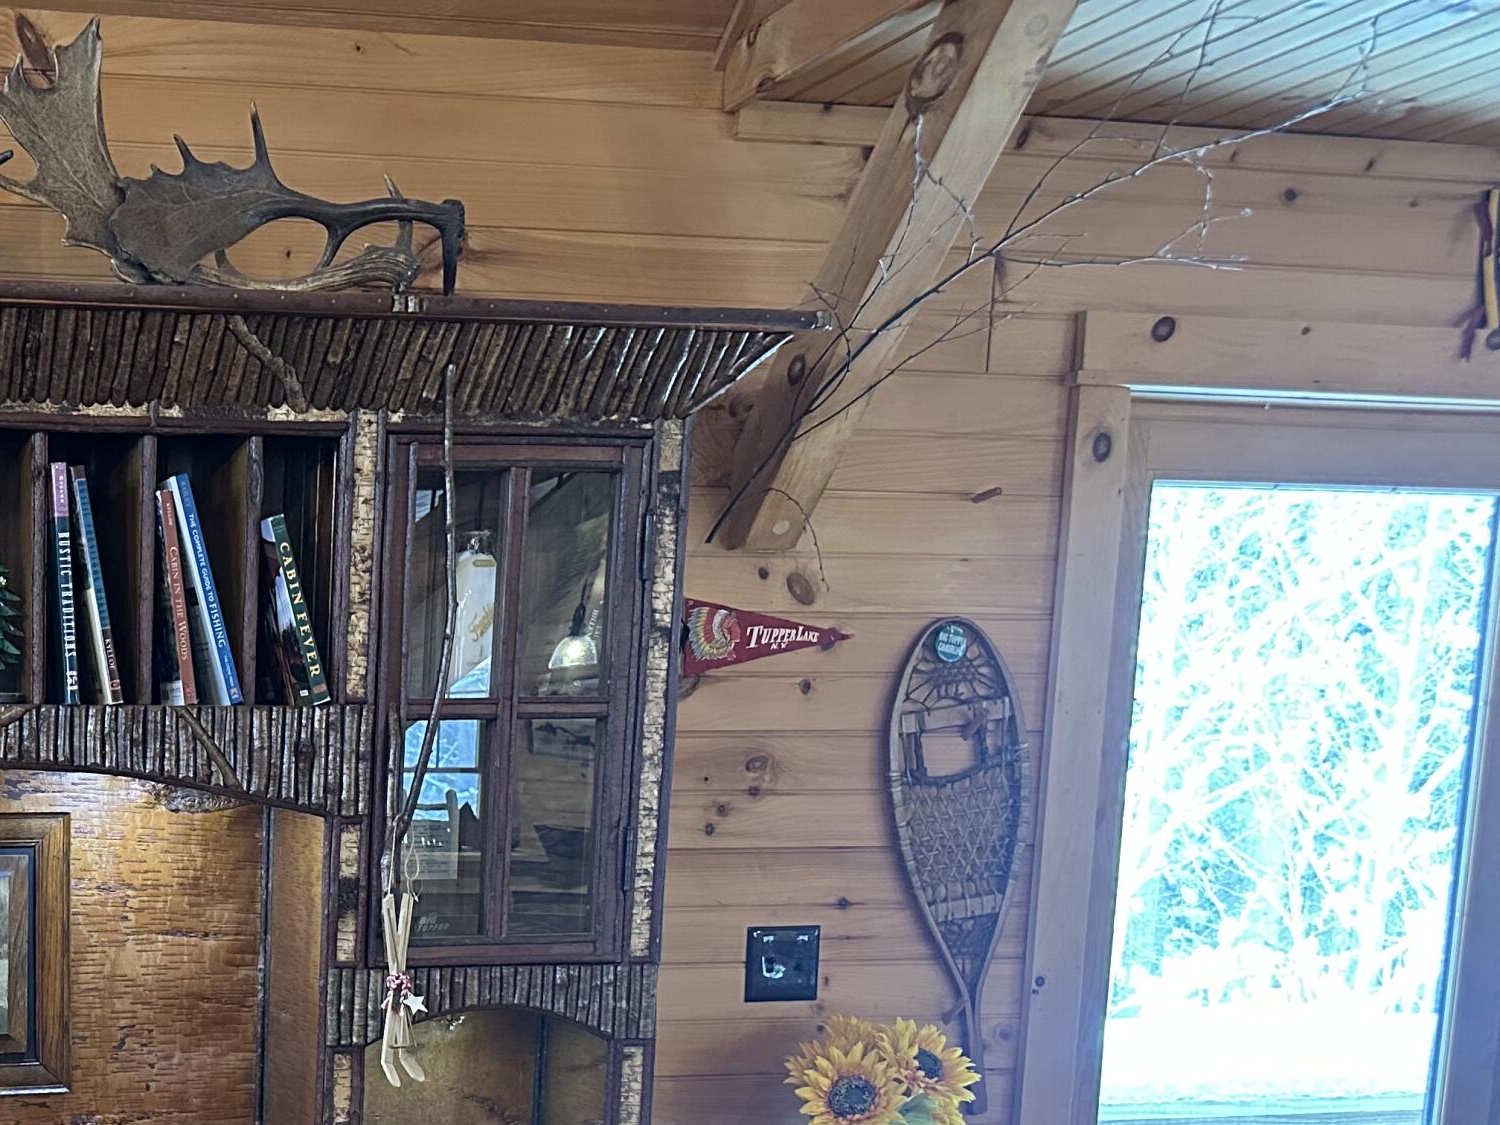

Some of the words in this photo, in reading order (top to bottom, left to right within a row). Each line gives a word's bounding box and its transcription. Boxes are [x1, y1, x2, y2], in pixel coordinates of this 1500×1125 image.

[188, 513, 197, 527] THE
[58, 532, 72, 576] RUSTIC
[169, 546, 180, 579] CABIN
[192, 530, 206, 567] COMPLETE
[173, 583, 181, 595] IN
[201, 569, 211, 590] GUIDE
[175, 599, 184, 618] THE
[207, 592, 214, 602] TO
[280, 542, 303, 605] CABIN
[296, 611, 321, 678] FEVER
[61, 582, 76, 657] TRADITIONS
[209, 604, 226, 648] FISHING
[178, 621, 189, 661] WOODS
[745, 625, 796, 649] TUPPER
[795, 625, 820, 643] LAKE
